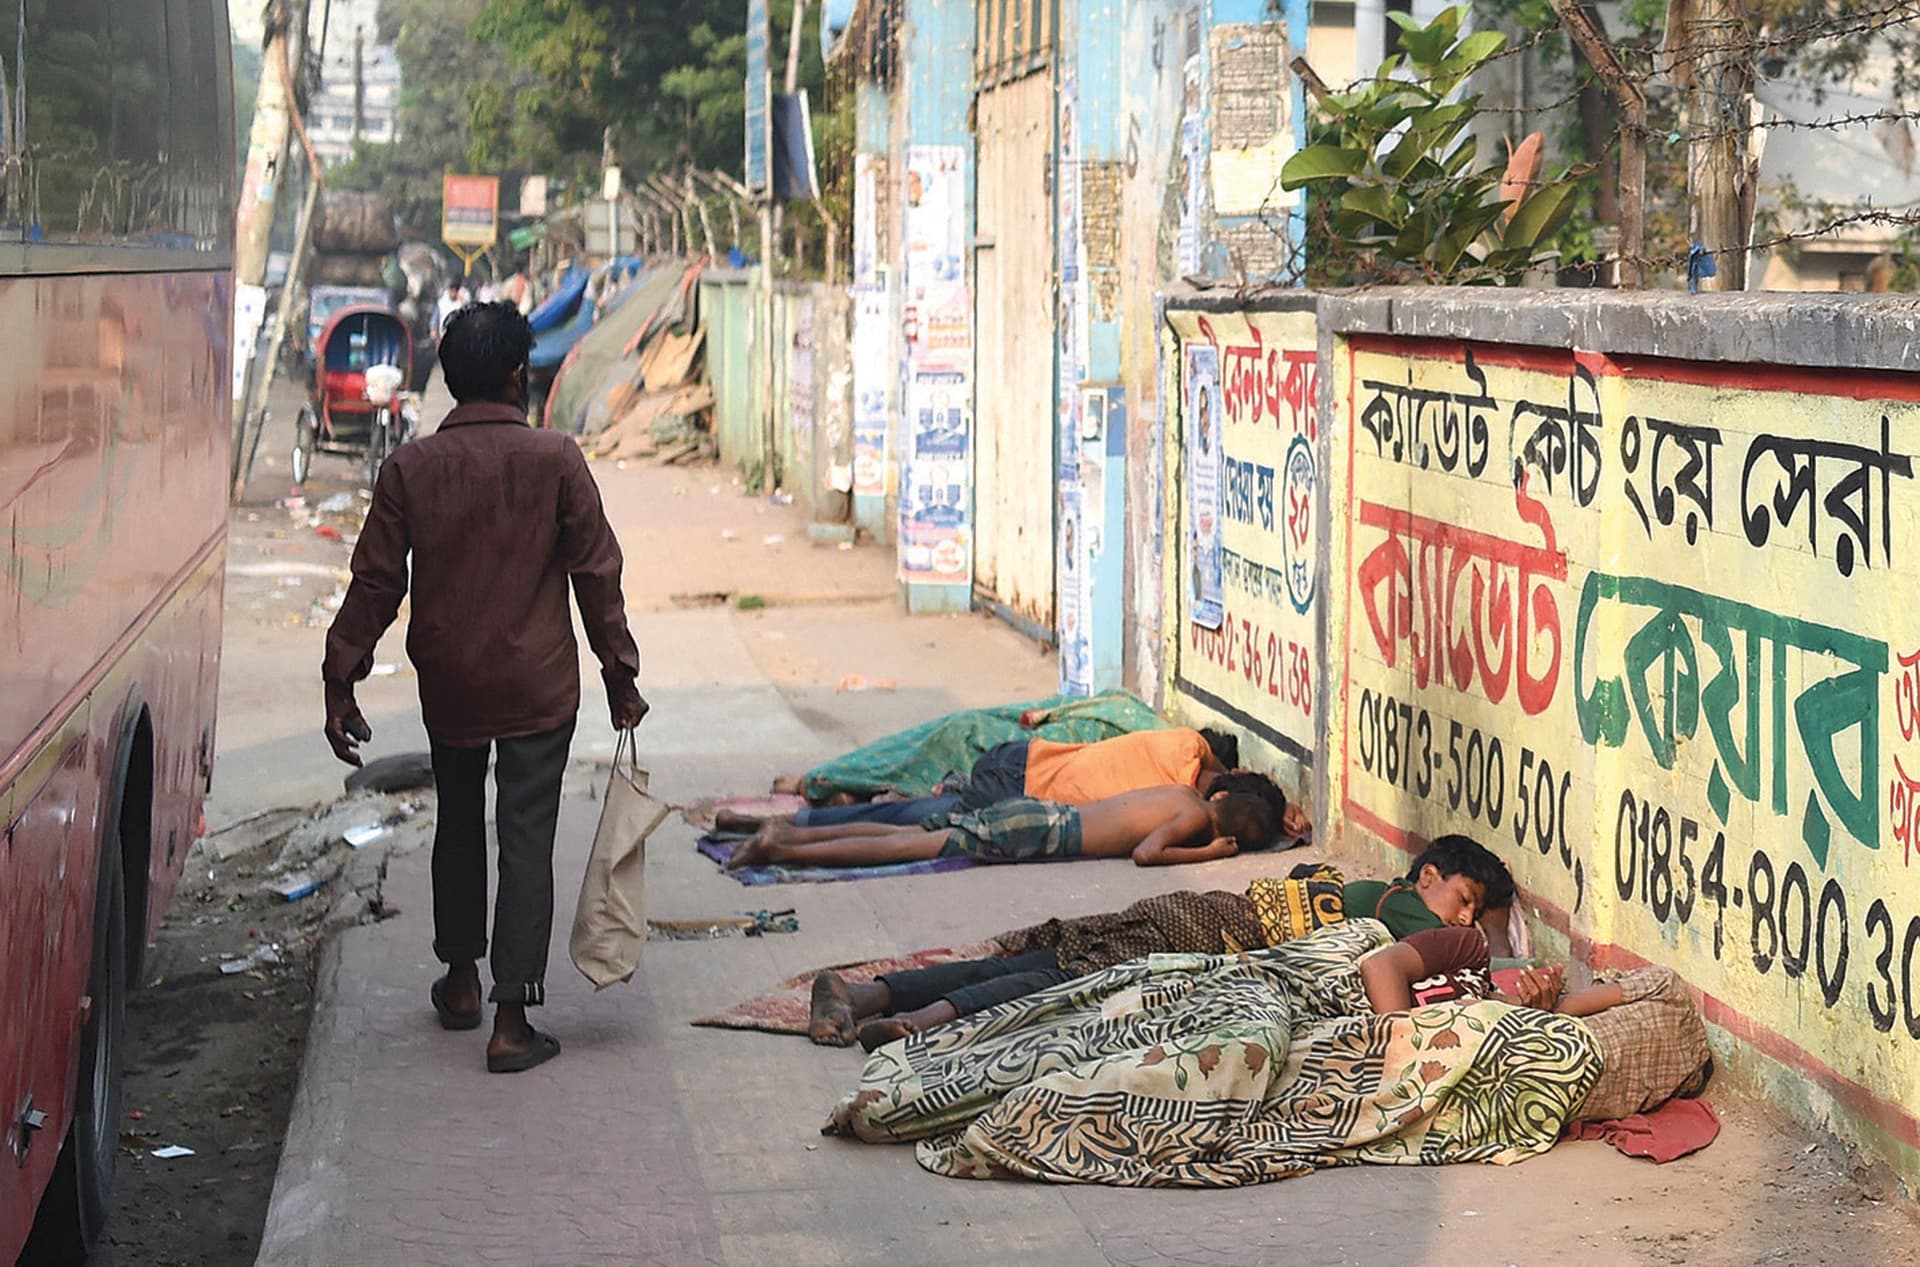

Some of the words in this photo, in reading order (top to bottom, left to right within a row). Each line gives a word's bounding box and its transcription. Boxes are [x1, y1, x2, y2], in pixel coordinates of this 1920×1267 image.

[1361, 349, 1498, 478] ক্যাডেট
[1741, 416, 1915, 577] সেরা
[1358, 469, 1568, 715] ক্যাডেট
[1574, 571, 1889, 873] কেয়ার
[1615, 789, 1850, 1009] 01854-800
